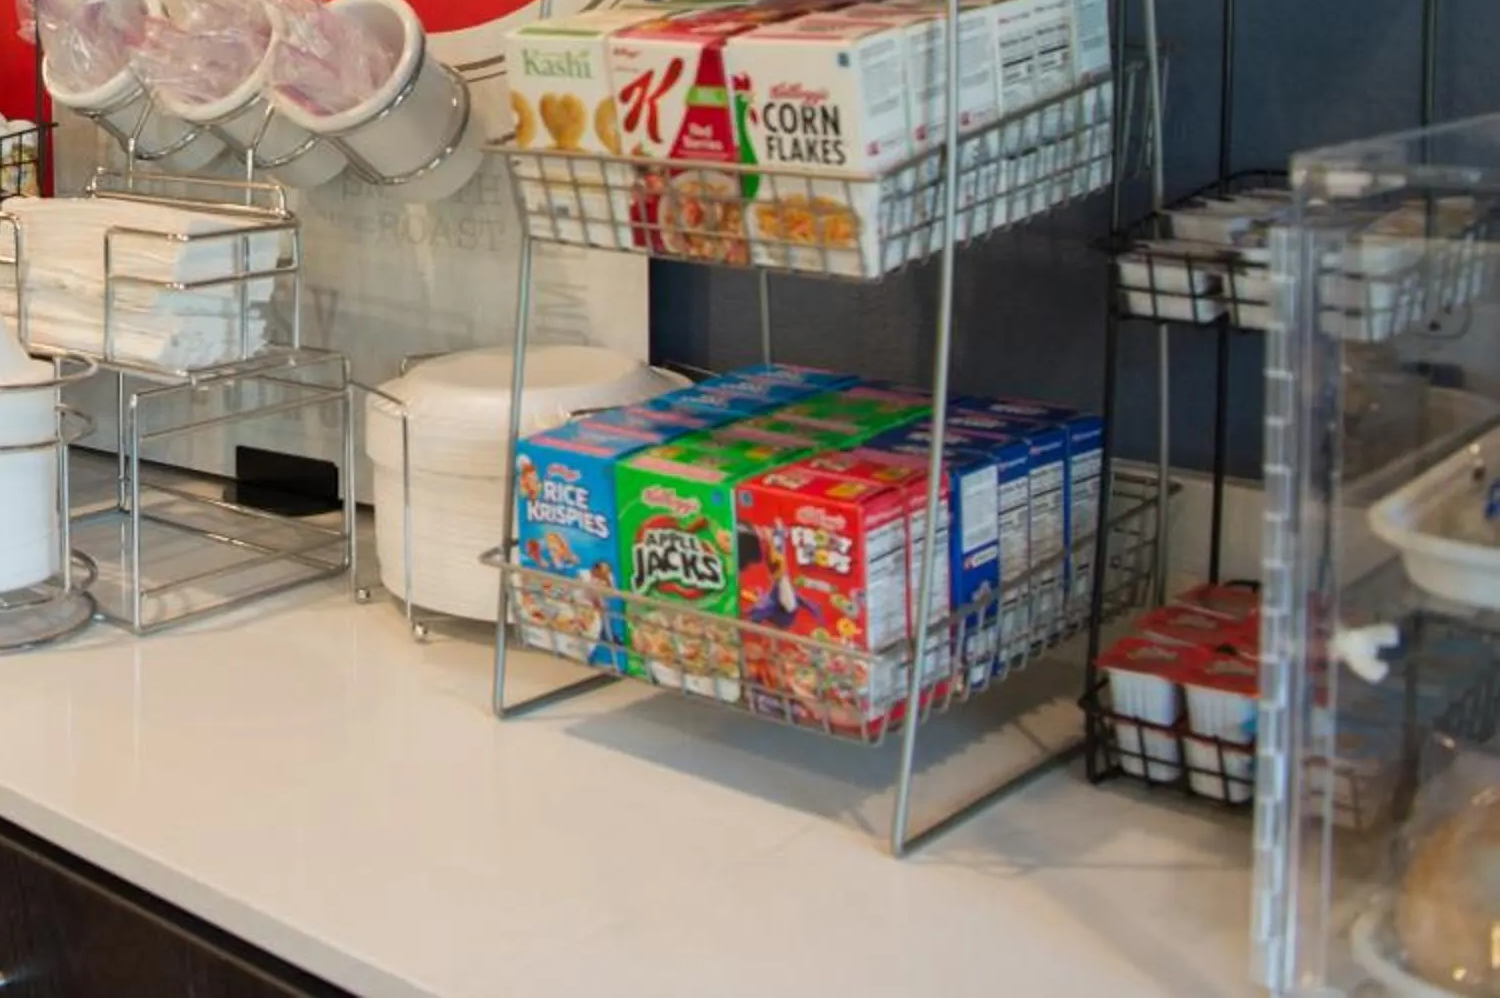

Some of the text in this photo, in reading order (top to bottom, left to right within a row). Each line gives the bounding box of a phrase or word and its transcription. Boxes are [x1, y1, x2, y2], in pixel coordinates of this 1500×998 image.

[523, 49, 594, 79] Kashi
[619, 57, 684, 144] K
[763, 103, 841, 136] CORN
[766, 136, 846, 165] FLAKES
[543, 480, 589, 510] RICE
[527, 500, 610, 539] KRISPIES
[645, 531, 700, 552] APPLE
[635, 546, 723, 590] JACKS
